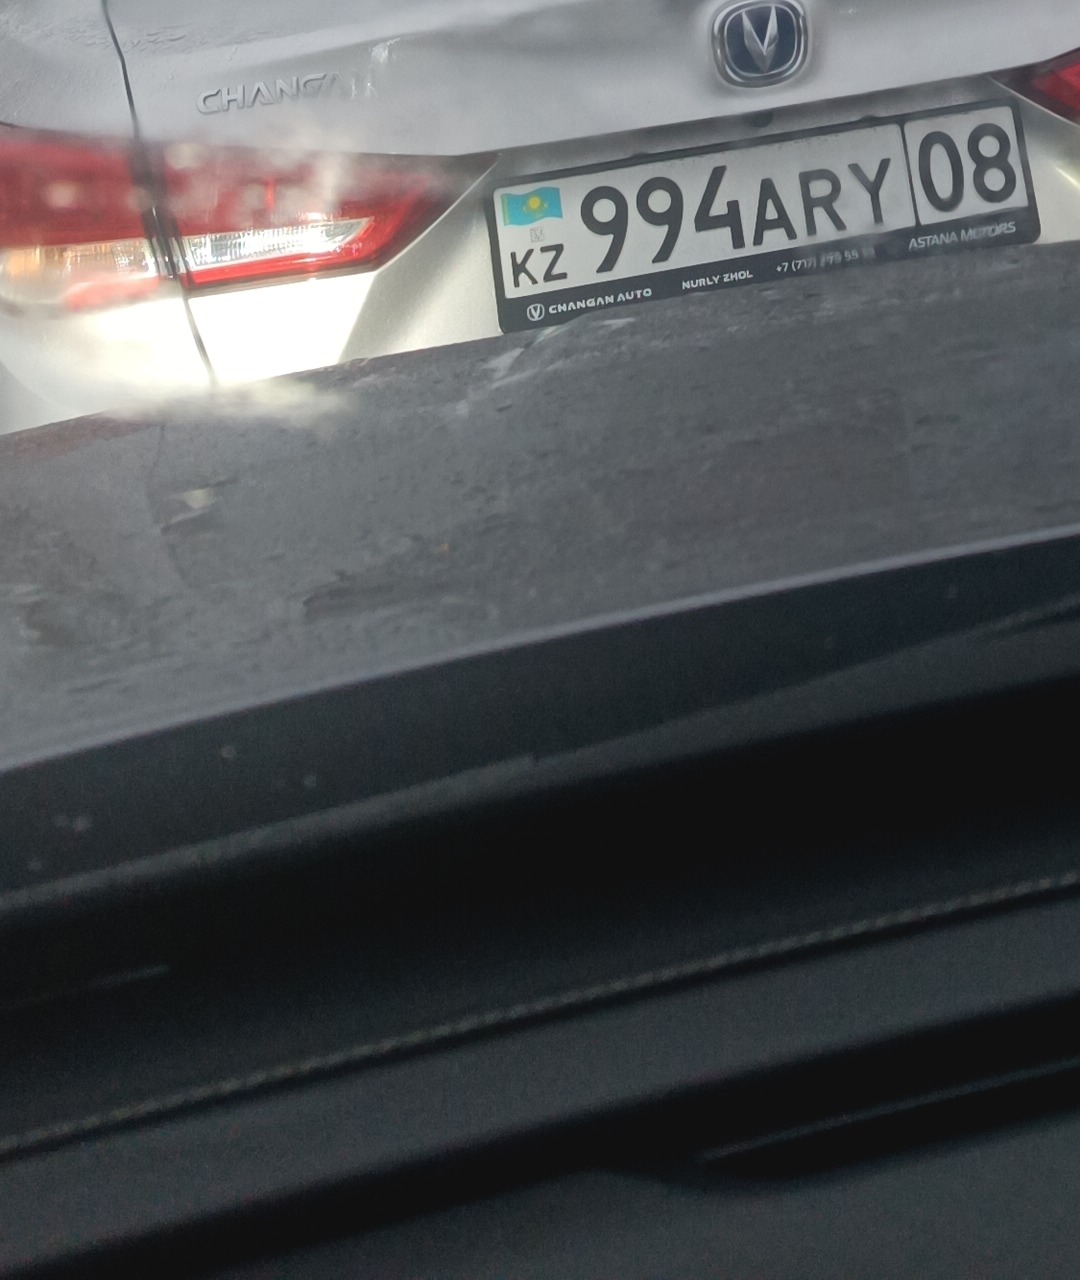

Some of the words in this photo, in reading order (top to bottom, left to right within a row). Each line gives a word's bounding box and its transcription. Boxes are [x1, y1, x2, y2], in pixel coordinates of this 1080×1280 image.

[196, 70, 360, 115] CHANG
[510, 243, 568, 289] KZ
[580, 157, 892, 274] 994ARY
[917, 122, 1018, 213] 08
[548, 295, 615, 315] CHANGAN
[616, 287, 653, 303] AUTO
[681, 274, 721, 291] NURLY
[722, 269, 754, 284] ZHOL
[908, 231, 959, 250] ASTANA
